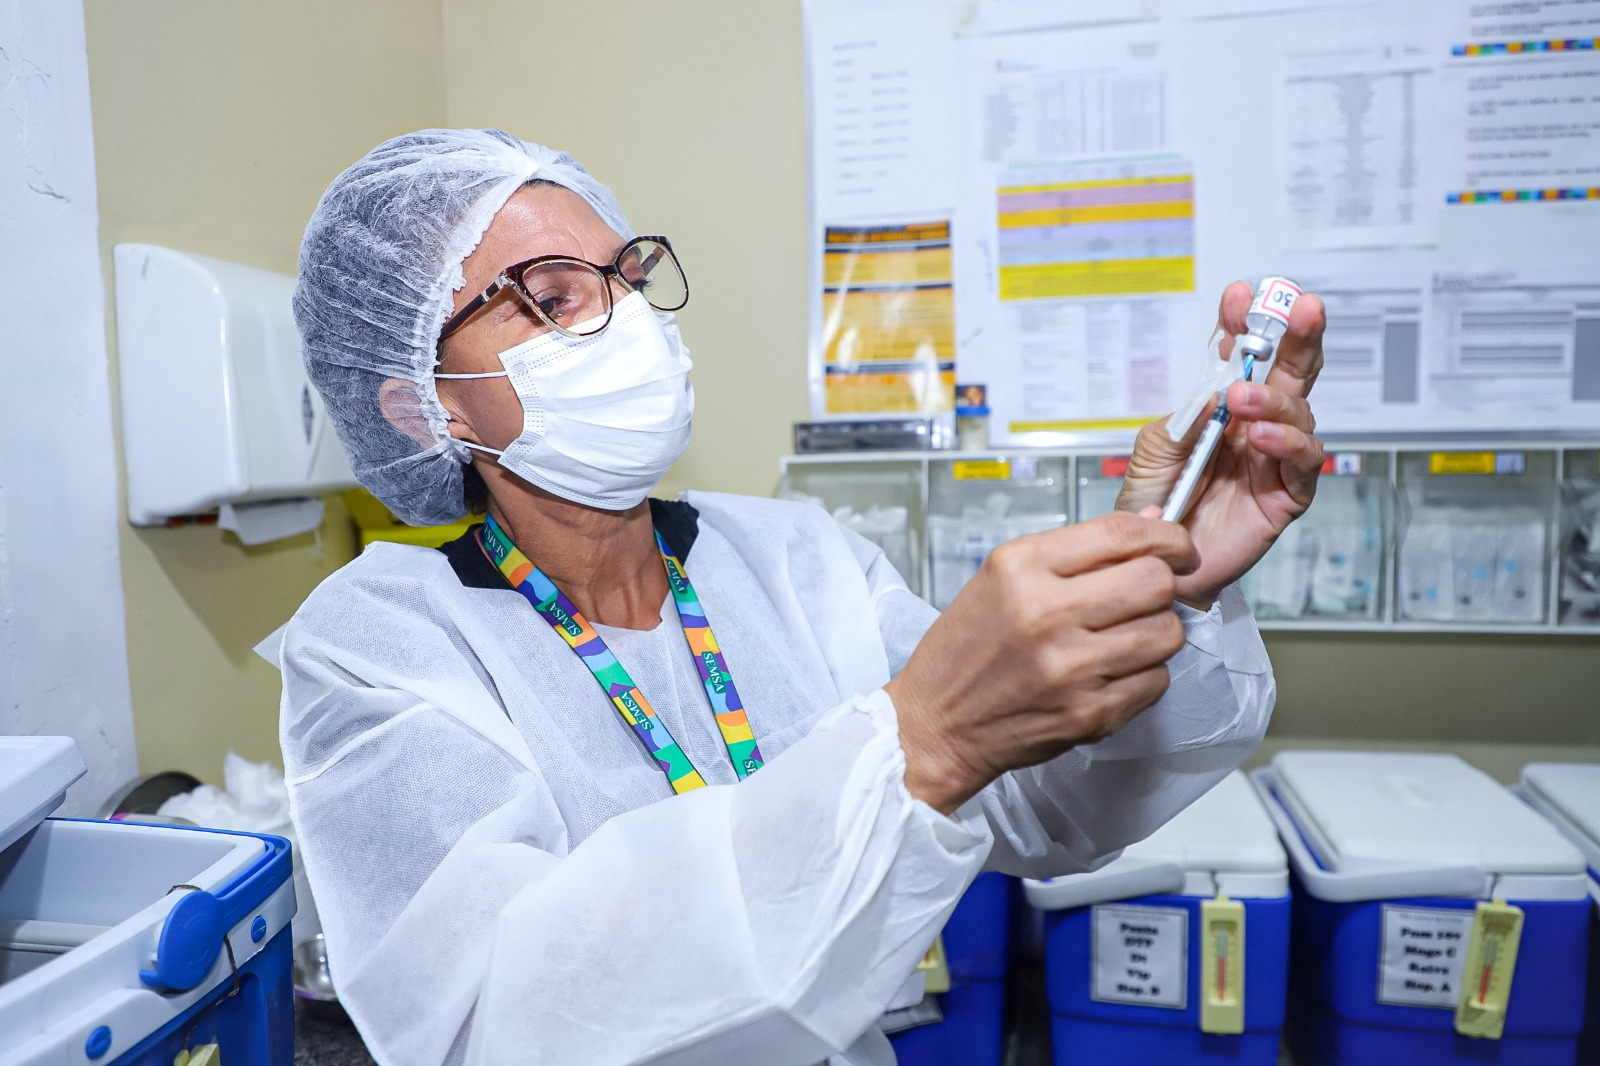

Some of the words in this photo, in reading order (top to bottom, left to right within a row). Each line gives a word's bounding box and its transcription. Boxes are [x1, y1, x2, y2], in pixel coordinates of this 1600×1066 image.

[1273, 290, 1293, 307] 30
[550, 602, 581, 636] SEMSA
[703, 652, 725, 692] SEMSA
[621, 691, 652, 730] SEMSA
